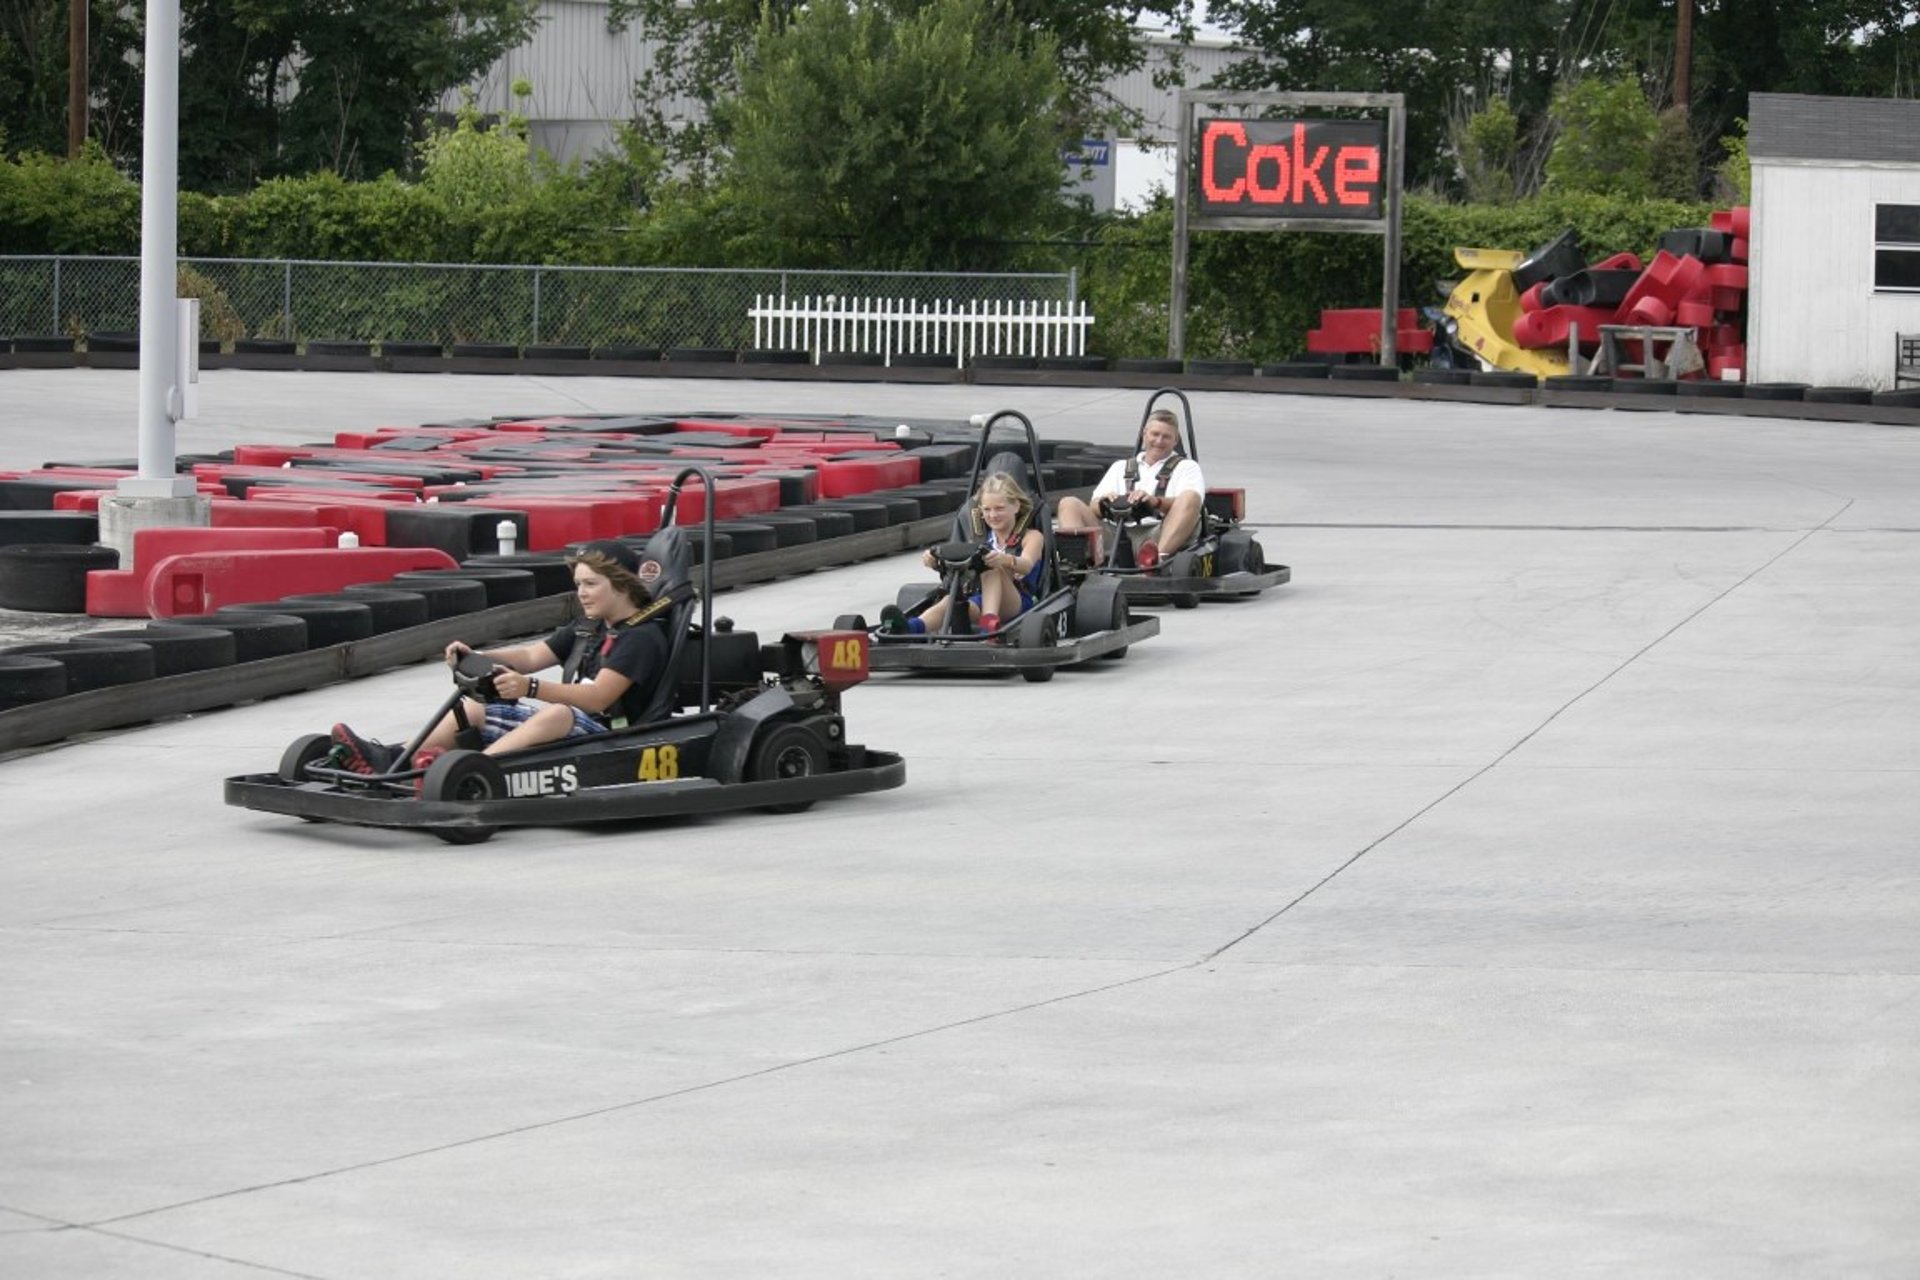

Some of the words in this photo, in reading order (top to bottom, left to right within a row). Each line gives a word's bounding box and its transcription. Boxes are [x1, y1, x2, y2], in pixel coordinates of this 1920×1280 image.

[1202, 121, 1381, 205] Coke
[832, 639, 861, 669] 48
[638, 744, 678, 781] 48
[504, 764, 578, 797] WE'S
